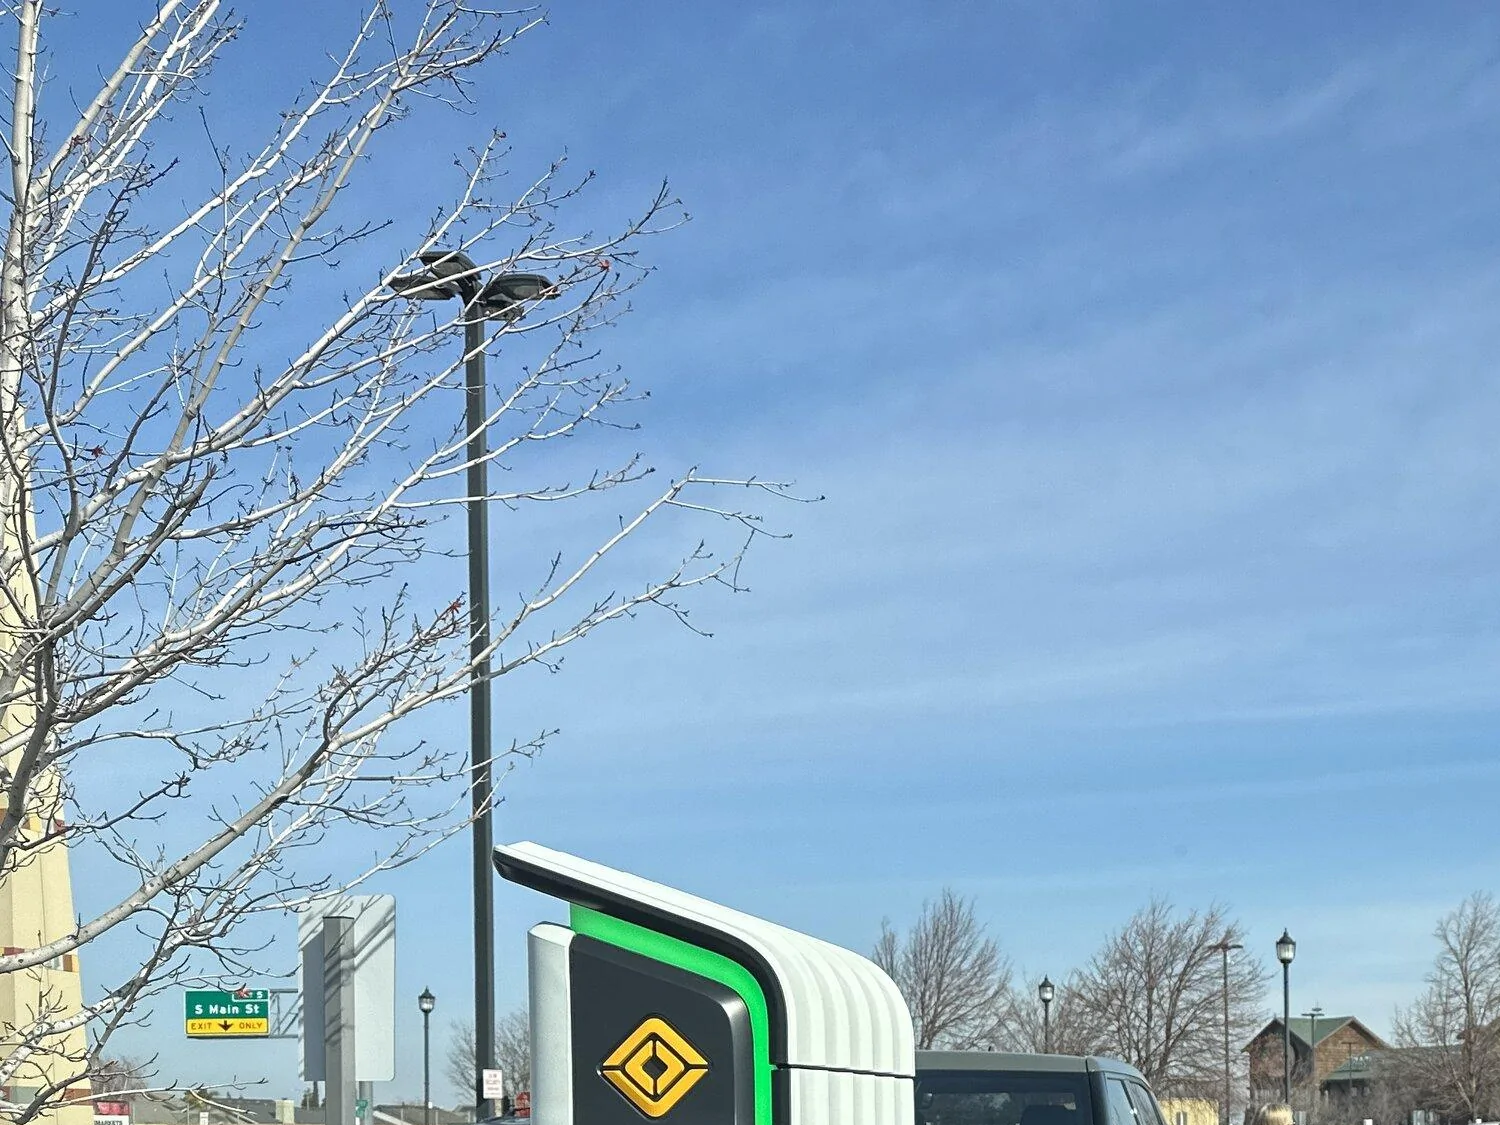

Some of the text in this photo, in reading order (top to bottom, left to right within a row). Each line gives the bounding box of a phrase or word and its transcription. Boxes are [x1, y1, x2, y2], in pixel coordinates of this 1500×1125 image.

[194, 1003, 260, 1015] S Main St
[191, 1022, 263, 1030] EXIT ONLY
